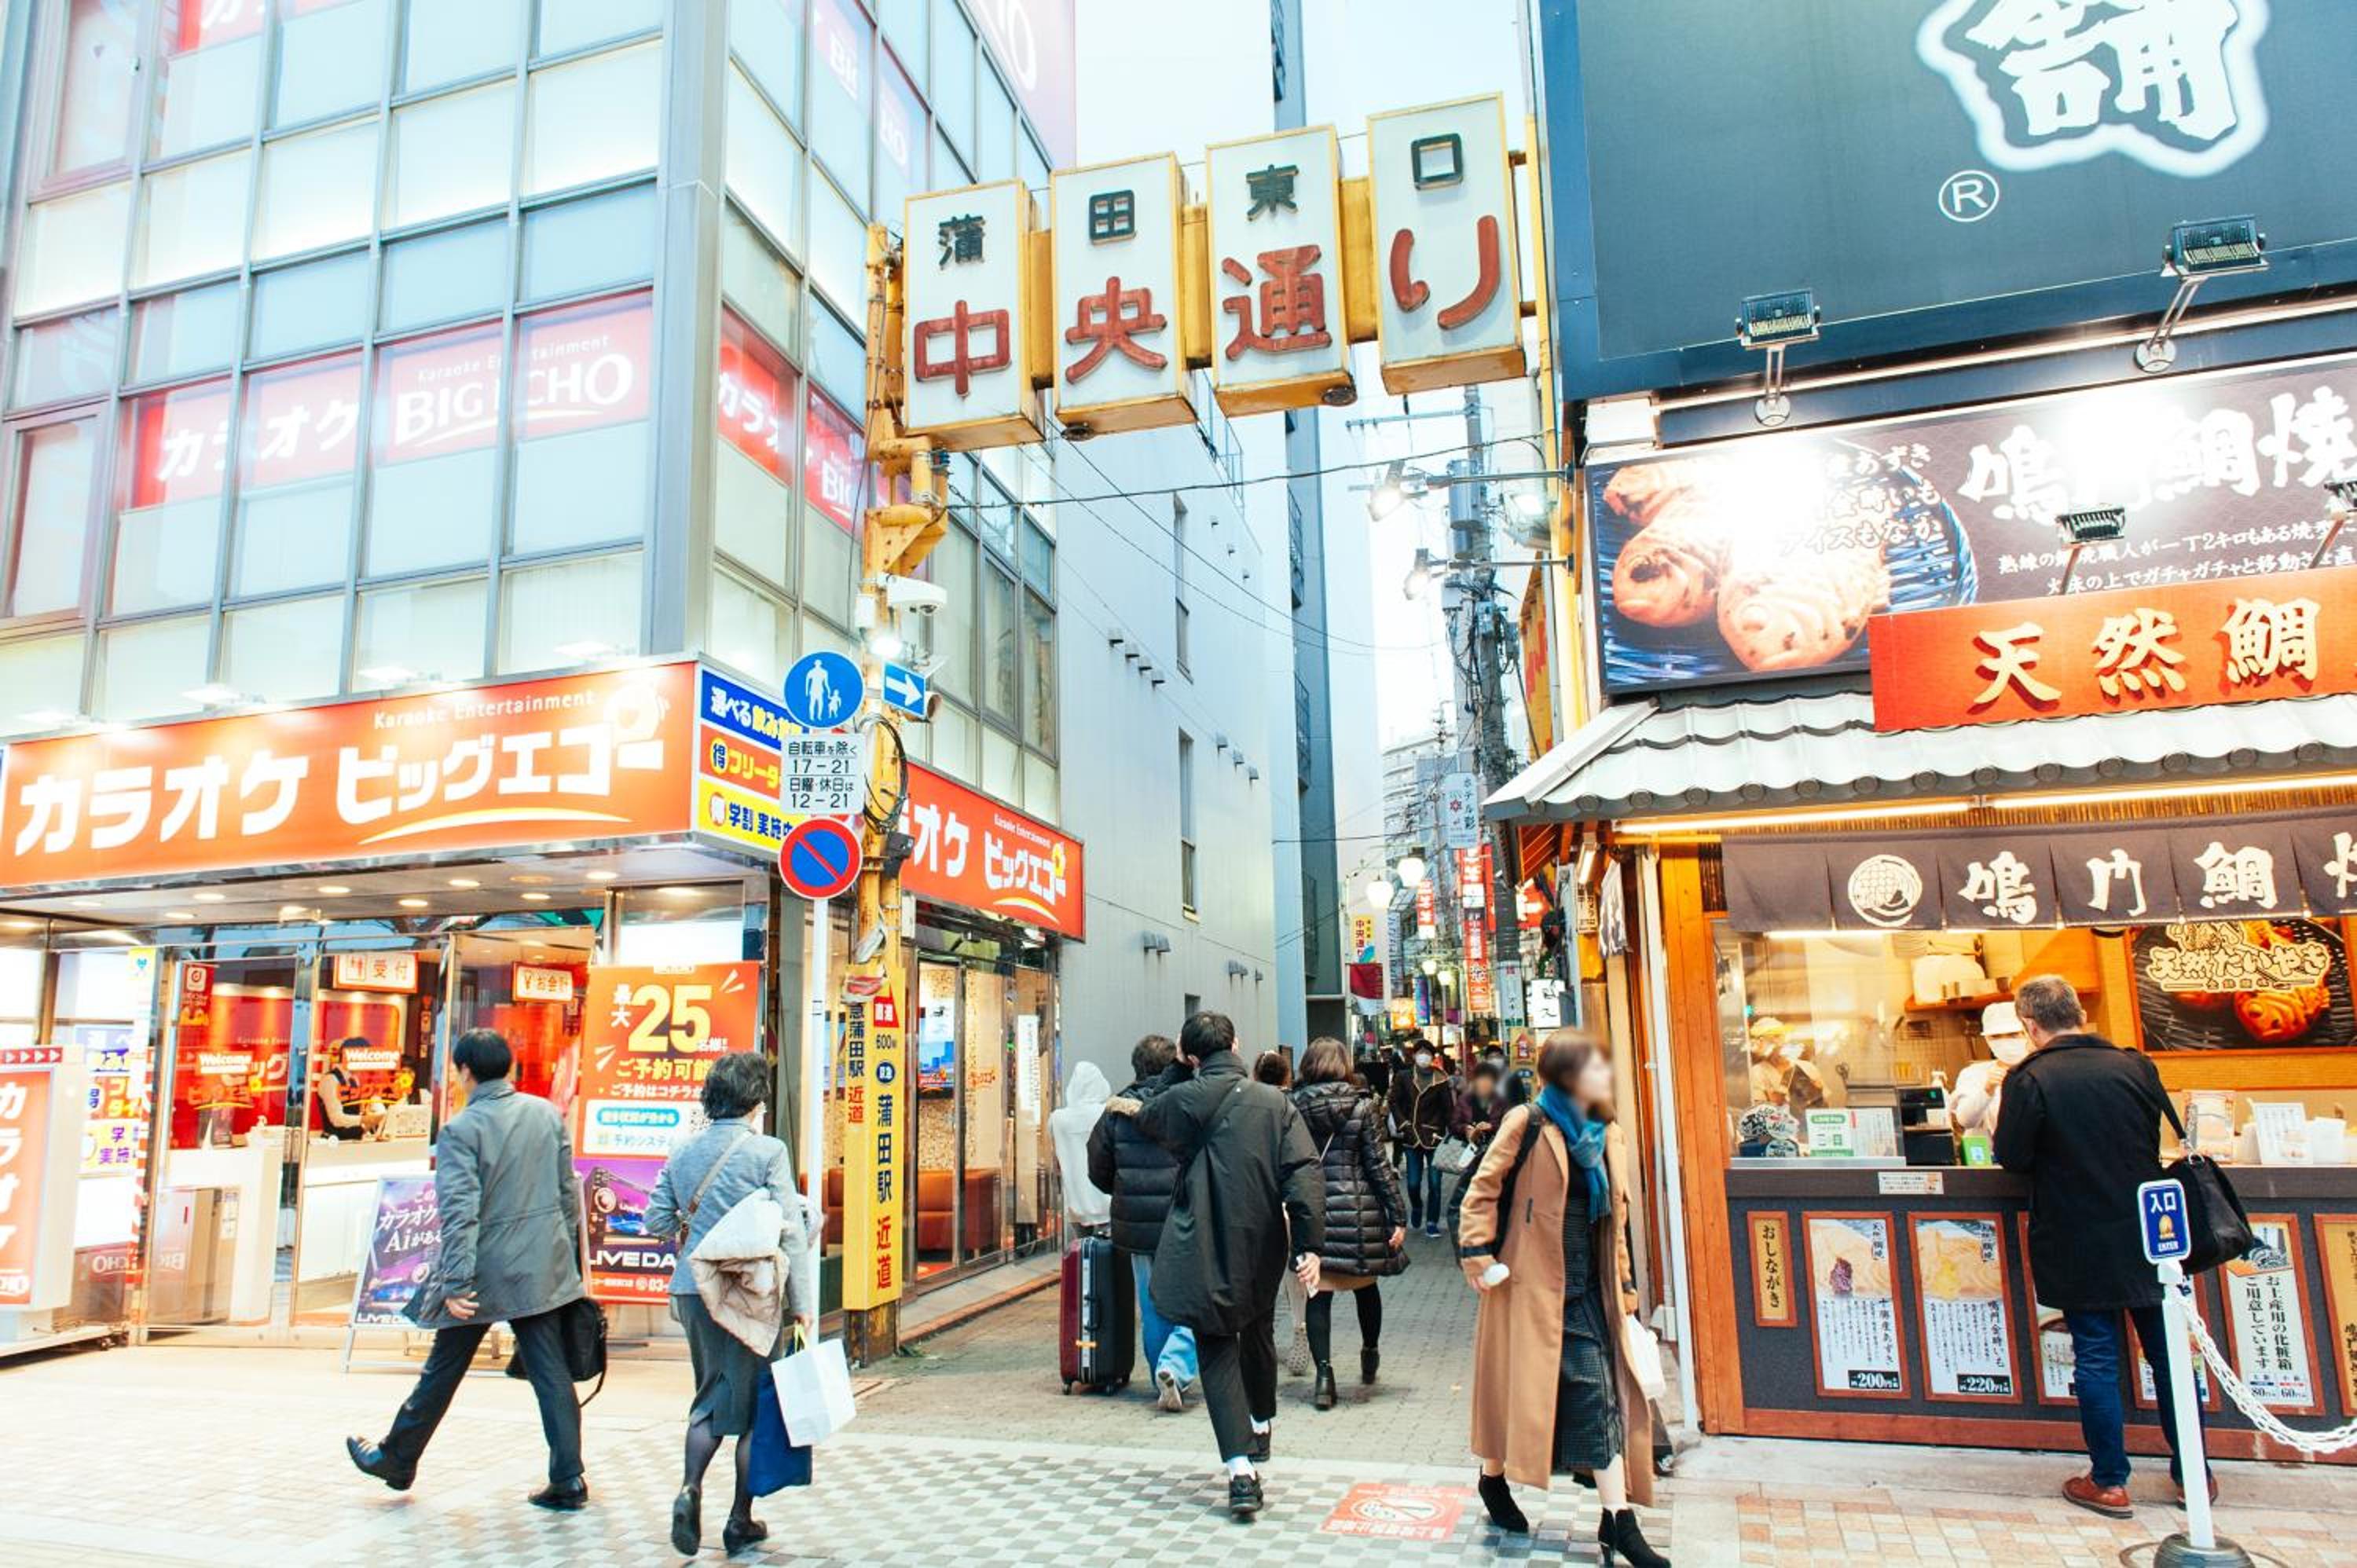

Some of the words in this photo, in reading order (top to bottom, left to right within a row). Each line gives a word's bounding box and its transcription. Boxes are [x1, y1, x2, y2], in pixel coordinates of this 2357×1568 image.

[939, 133, 1463, 270] 蒲田東口
[914, 215, 1501, 398] 中央通り
[395, 383, 483, 446] BIG
[495, 353, 634, 410] CHO
[1958, 385, 2357, 525] 鳴鯛焼
[1970, 597, 2322, 710] 天然鯛
[374, 705, 446, 730] Karaoke
[454, 690, 596, 720] Entertainment
[788, 741, 857, 756] 自転車を除く
[16, 750, 309, 856] カラオケ
[336, 723, 665, 826] ビッグエコー
[984, 830, 1066, 906] ビッグエコー
[628, 984, 713, 1054] 25
[616, 1058, 714, 1083] ご予約可能
[848, 1086, 864, 1124] 近道
[2150, 1192, 2176, 1214] 入口
[876, 1214, 893, 1291] 近道
[1761, 1225, 1780, 1309] おしながき
